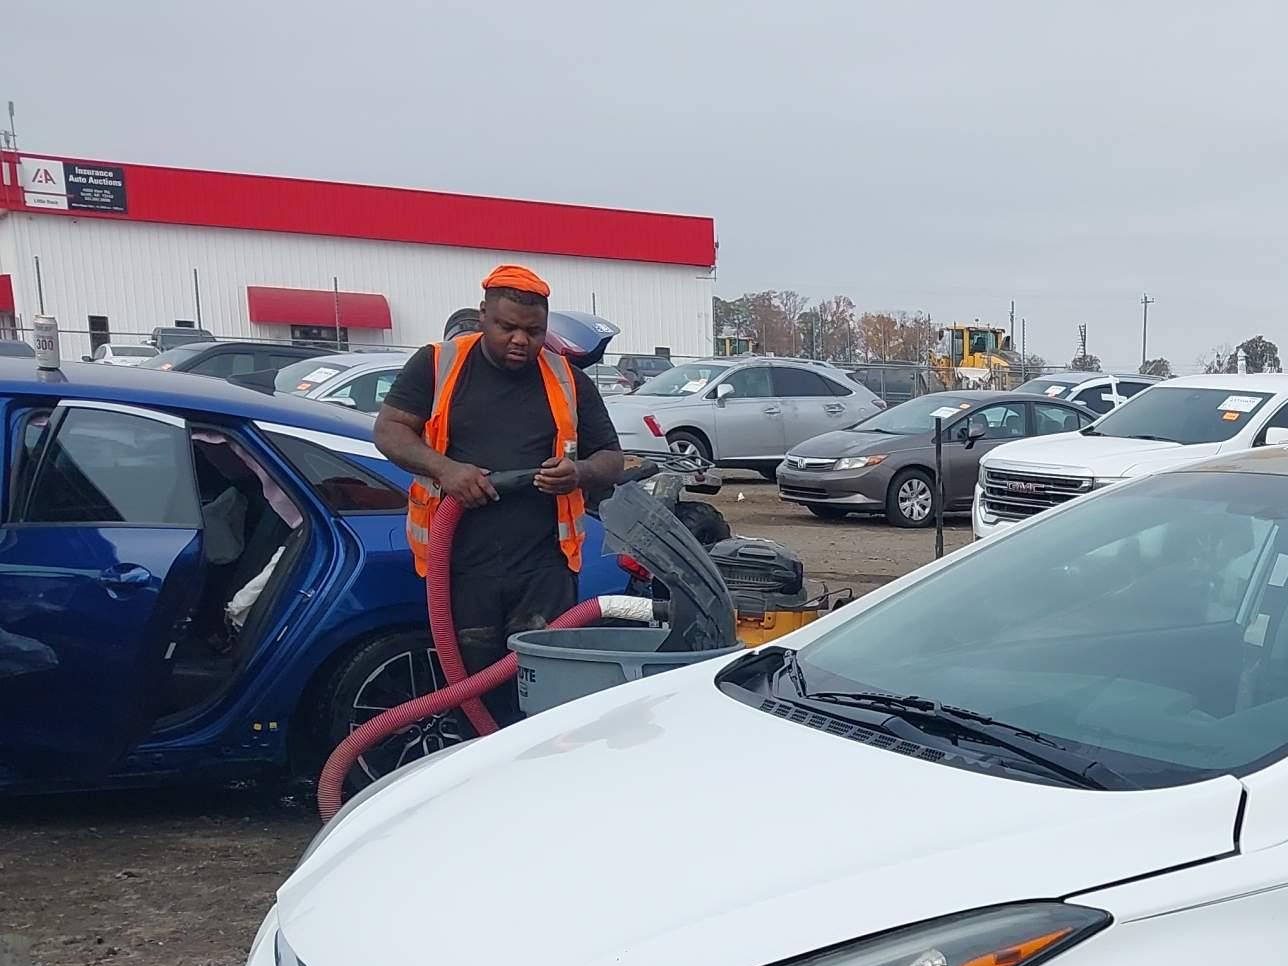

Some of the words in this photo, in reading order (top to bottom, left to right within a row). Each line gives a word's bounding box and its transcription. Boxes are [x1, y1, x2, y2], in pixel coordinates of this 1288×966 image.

[75, 166, 113, 178] Insurance
[68, 174, 87, 184] Auto
[88, 176, 122, 187] Auctions
[36, 338, 54, 351] 300
[1007, 481, 1045, 495] GMC
